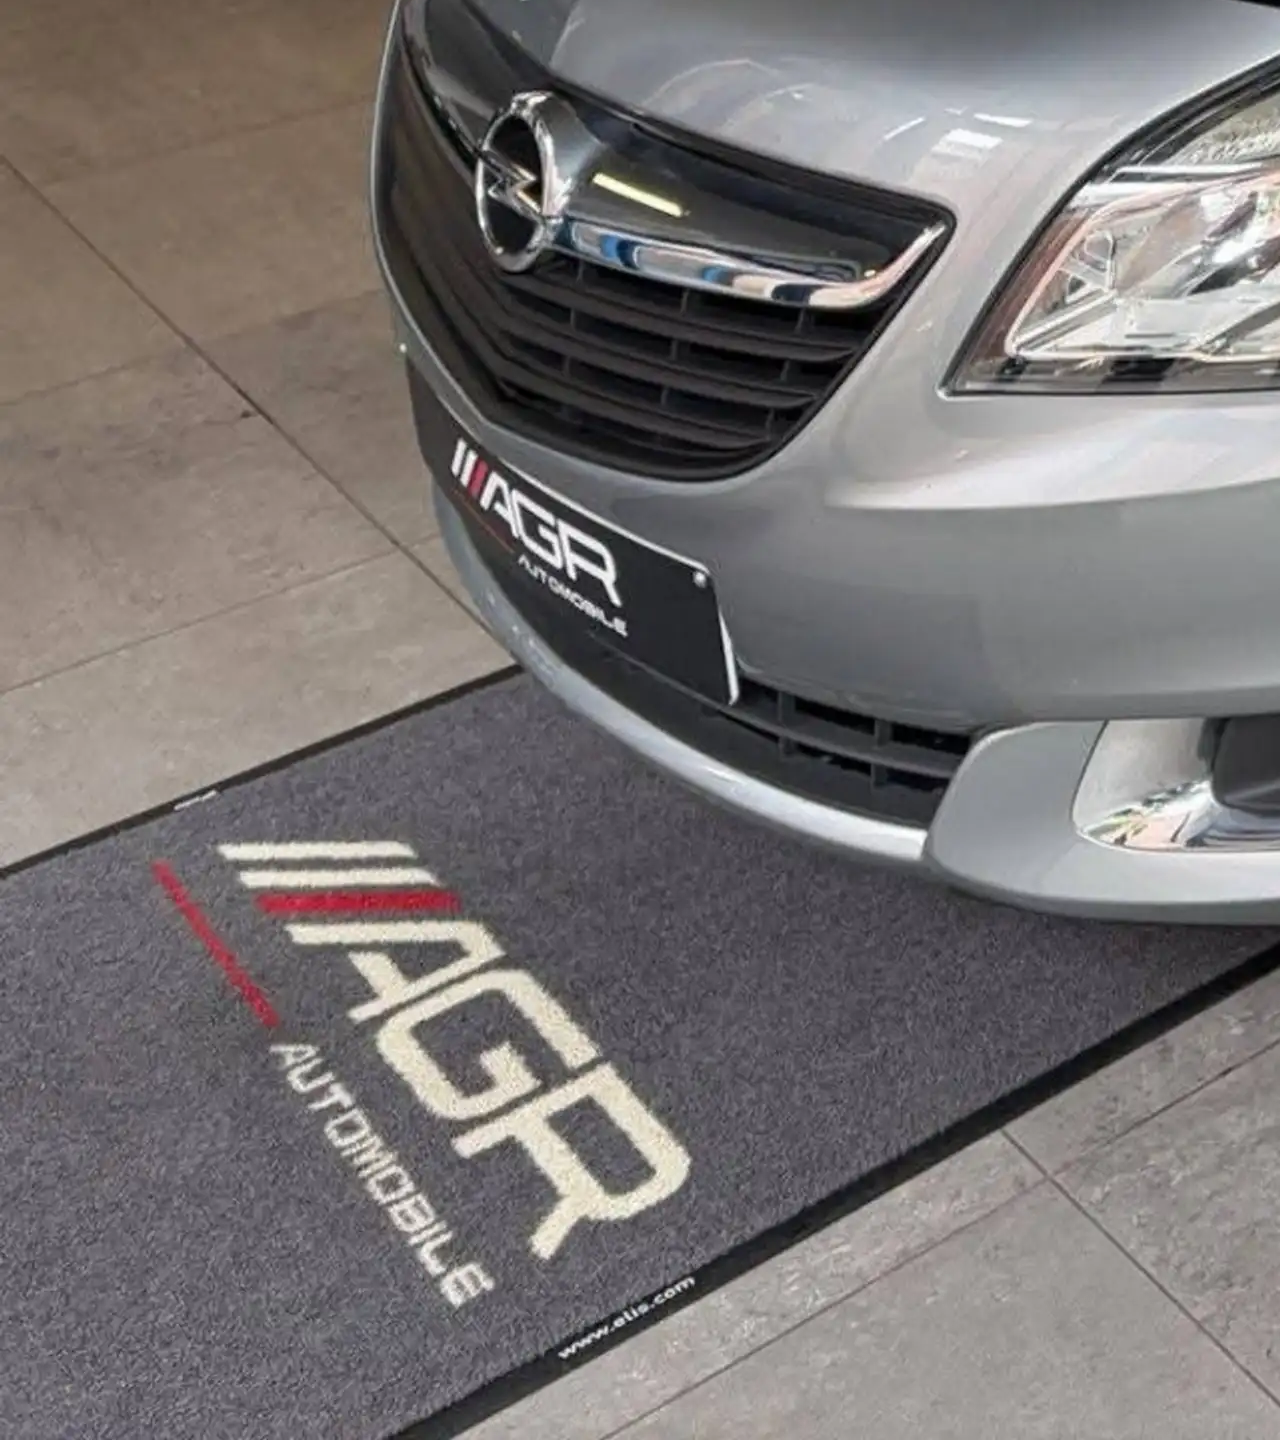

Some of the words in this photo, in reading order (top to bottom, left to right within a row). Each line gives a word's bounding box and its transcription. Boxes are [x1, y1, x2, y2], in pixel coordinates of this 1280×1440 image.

[479, 471, 622, 607] AGR
[518, 554, 628, 637] AUTOMOBILE
[284, 919, 691, 1260] AGR
[270, 1043, 495, 1308] AUTOMOBILE
[558, 1276, 696, 1359] www.elis.com
